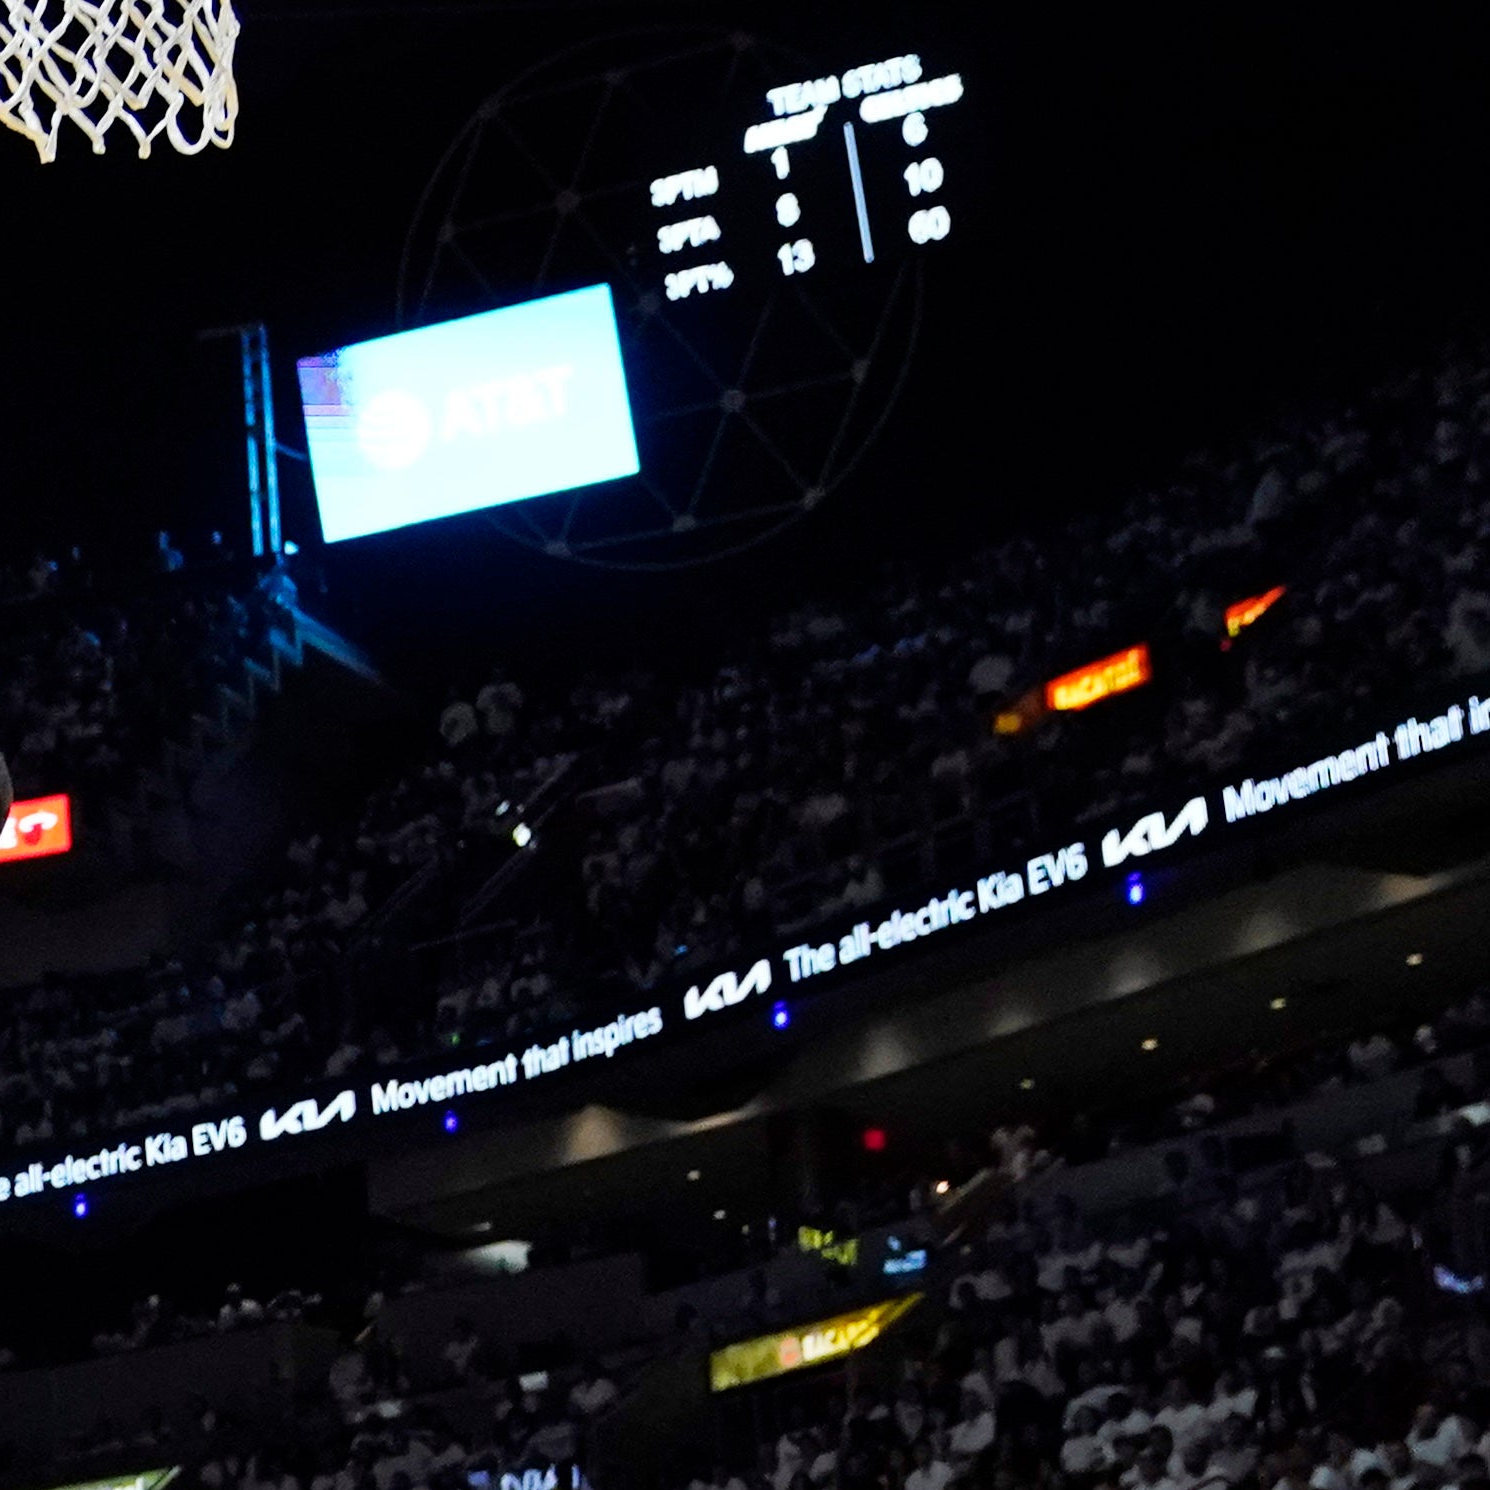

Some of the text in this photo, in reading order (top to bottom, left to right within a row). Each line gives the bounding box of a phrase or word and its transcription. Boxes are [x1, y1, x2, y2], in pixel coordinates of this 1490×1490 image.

[904, 157, 944, 196] 10
[441, 363, 573, 442] AT&T
[13, 1141, 144, 1198] all-electric
[144, 1132, 189, 1167] Kia
[191, 1115, 248, 1157] EV6
[370, 1052, 519, 1116] Movement
[520, 1035, 571, 1081] that
[571, 1006, 664, 1058] inspires
[782, 942, 837, 983] The
[838, 888, 977, 966] all-electric
[976, 870, 1025, 914] Kia
[1026, 841, 1089, 896] EV6
[1222, 730, 1391, 823] Movement
[1393, 703, 1465, 761] that
